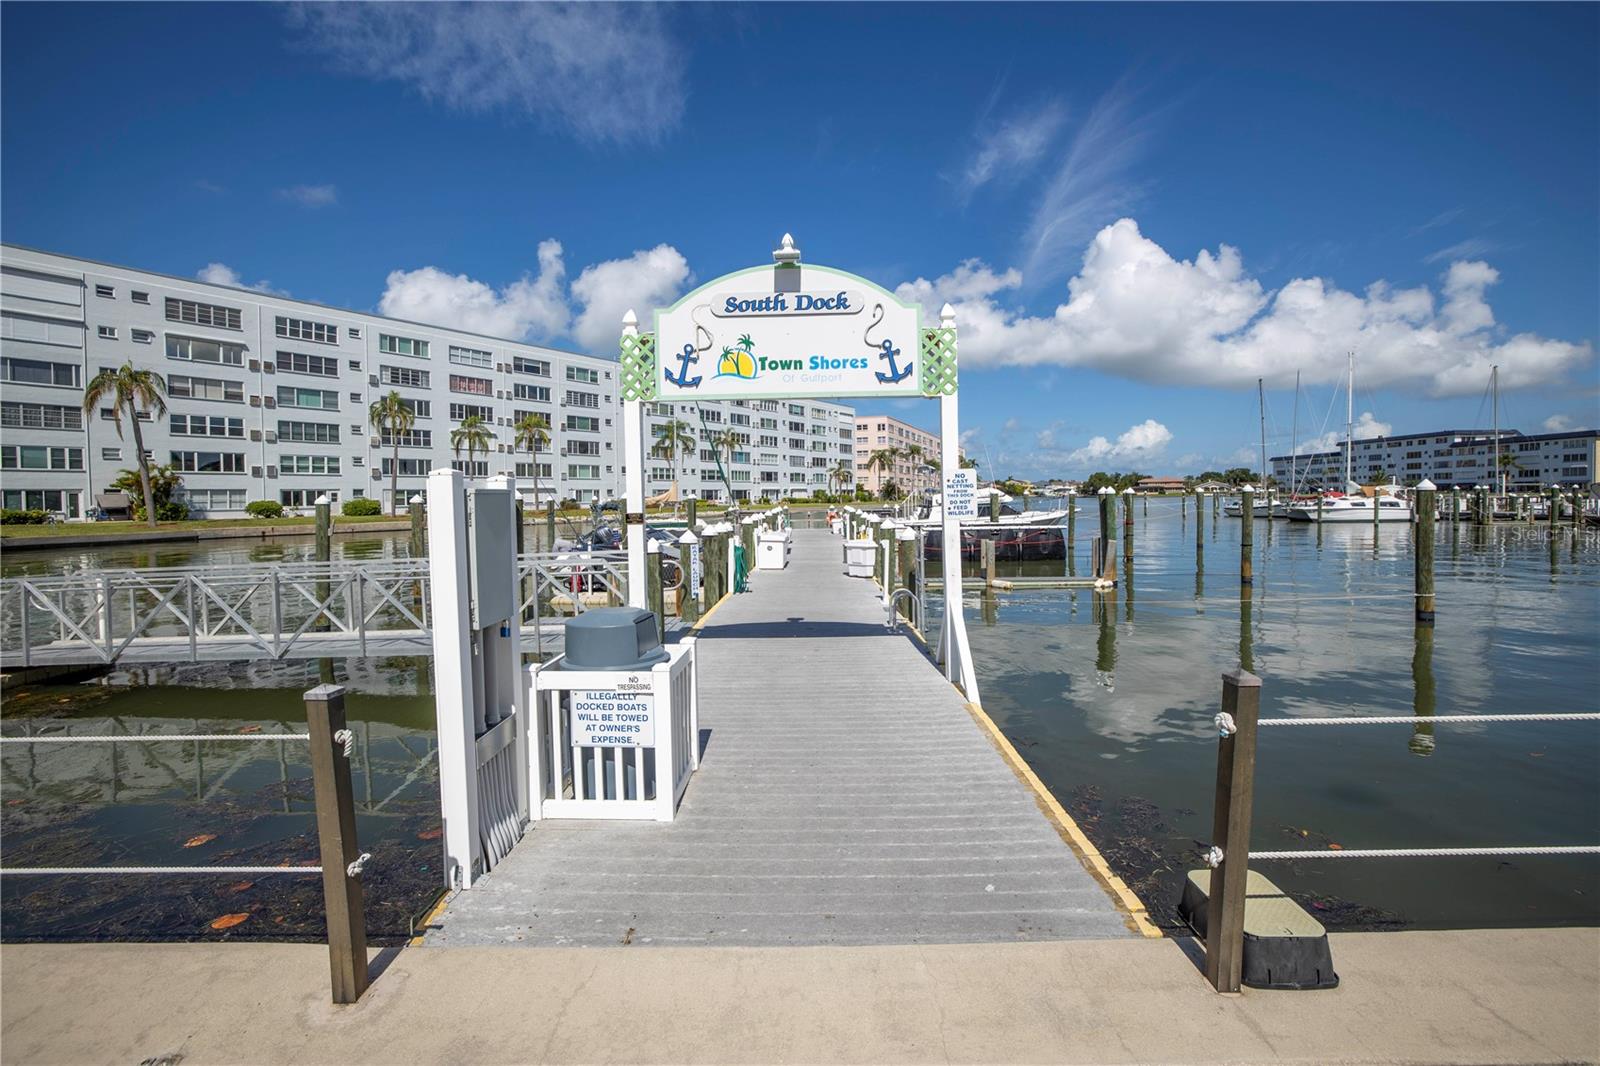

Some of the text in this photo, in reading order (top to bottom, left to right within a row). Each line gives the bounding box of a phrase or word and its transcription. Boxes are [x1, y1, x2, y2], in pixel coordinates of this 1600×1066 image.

[724, 291, 851, 313] South Dock
[758, 355, 868, 371] Town Shores
[576, 702, 648, 712] DOCKED BOATS
[578, 713, 648, 722] WILL BE TOWED
[586, 724, 640, 732] AT OWNER'S
[592, 736, 635, 744] EXPENSE.
